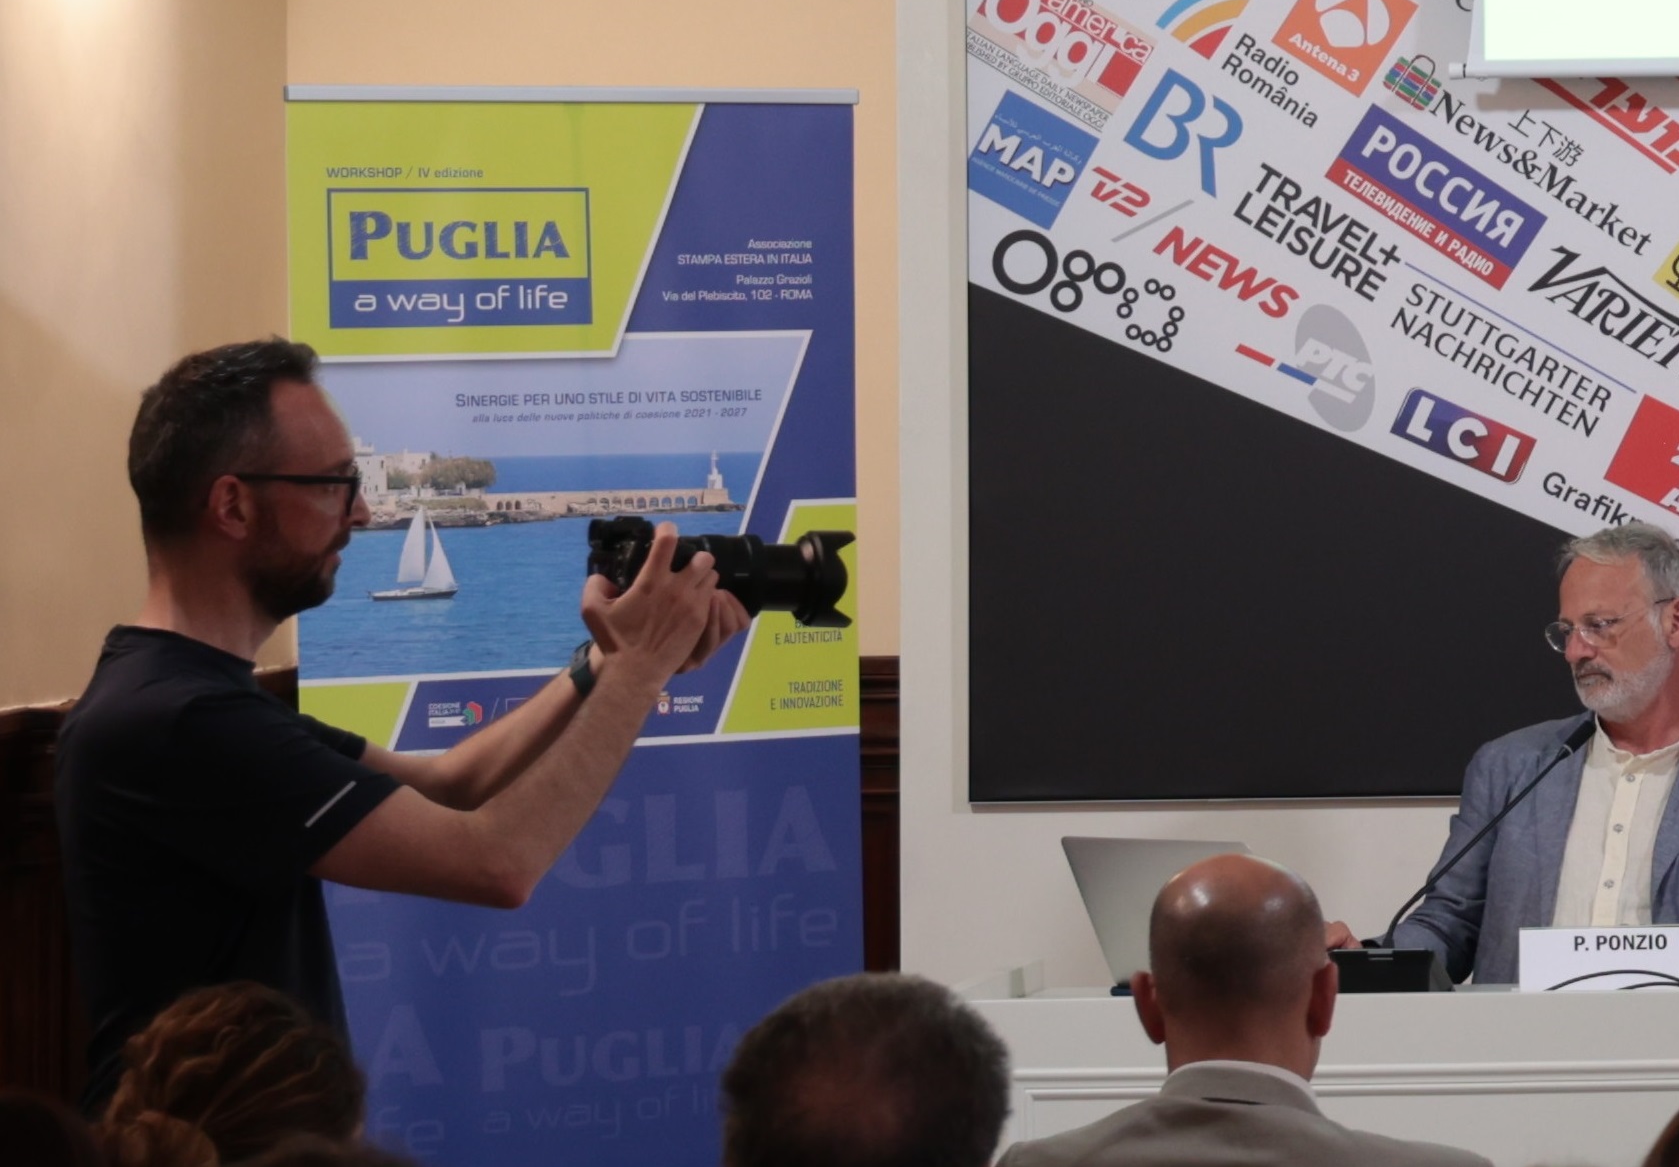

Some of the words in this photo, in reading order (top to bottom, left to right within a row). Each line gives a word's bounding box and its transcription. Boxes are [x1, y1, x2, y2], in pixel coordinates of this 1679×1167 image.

[1220, 57, 1321, 129] România
[1233, 33, 1302, 88] Radio
[326, 166, 403, 179] WORKSHOP
[433, 166, 484, 179] edizione
[976, 123, 1078, 191] MAP
[1359, 123, 1527, 251] РОССИЯ
[1428, 88, 1655, 258] News&Market
[348, 209, 571, 261] PUGLIA
[1232, 190, 1390, 303] LEISURE
[355, 290, 377, 312] a
[387, 289, 465, 323] way
[475, 284, 511, 310] of
[518, 284, 568, 310] life
[1152, 224, 1300, 319] NEWS
[1388, 306, 1601, 439] NACHRICHTEN
[1404, 281, 1613, 414] STUTTGARTER
[455, 392, 520, 408] SINERGIE
[680, 389, 763, 404] SOSTENIBILE
[1404, 395, 1520, 480] LCI
[779, 696, 844, 710] INNOVAZIONE
[788, 679, 843, 693] TRADIZIONE
[1573, 935, 1590, 952] P.
[1595, 933, 1668, 951] PONZIO
